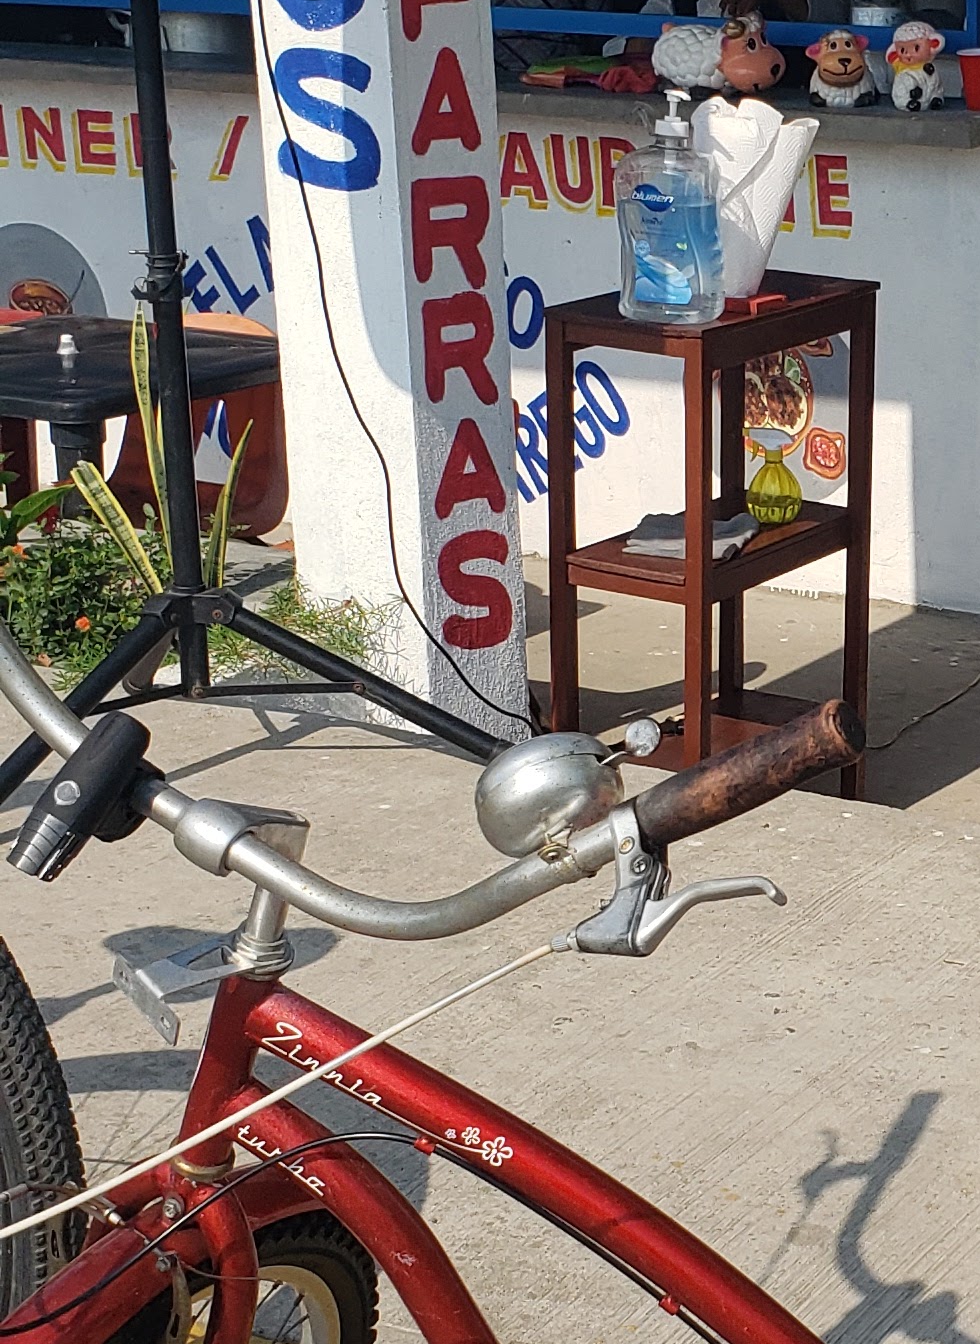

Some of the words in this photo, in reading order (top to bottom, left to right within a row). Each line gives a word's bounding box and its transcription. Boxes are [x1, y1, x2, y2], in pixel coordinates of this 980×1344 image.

[631, 190, 674, 204] blumen
[516, 360, 631, 504] REGO
[261, 1021, 382, 1107] Zinnia
[237, 1124, 325, 1197] turbo
